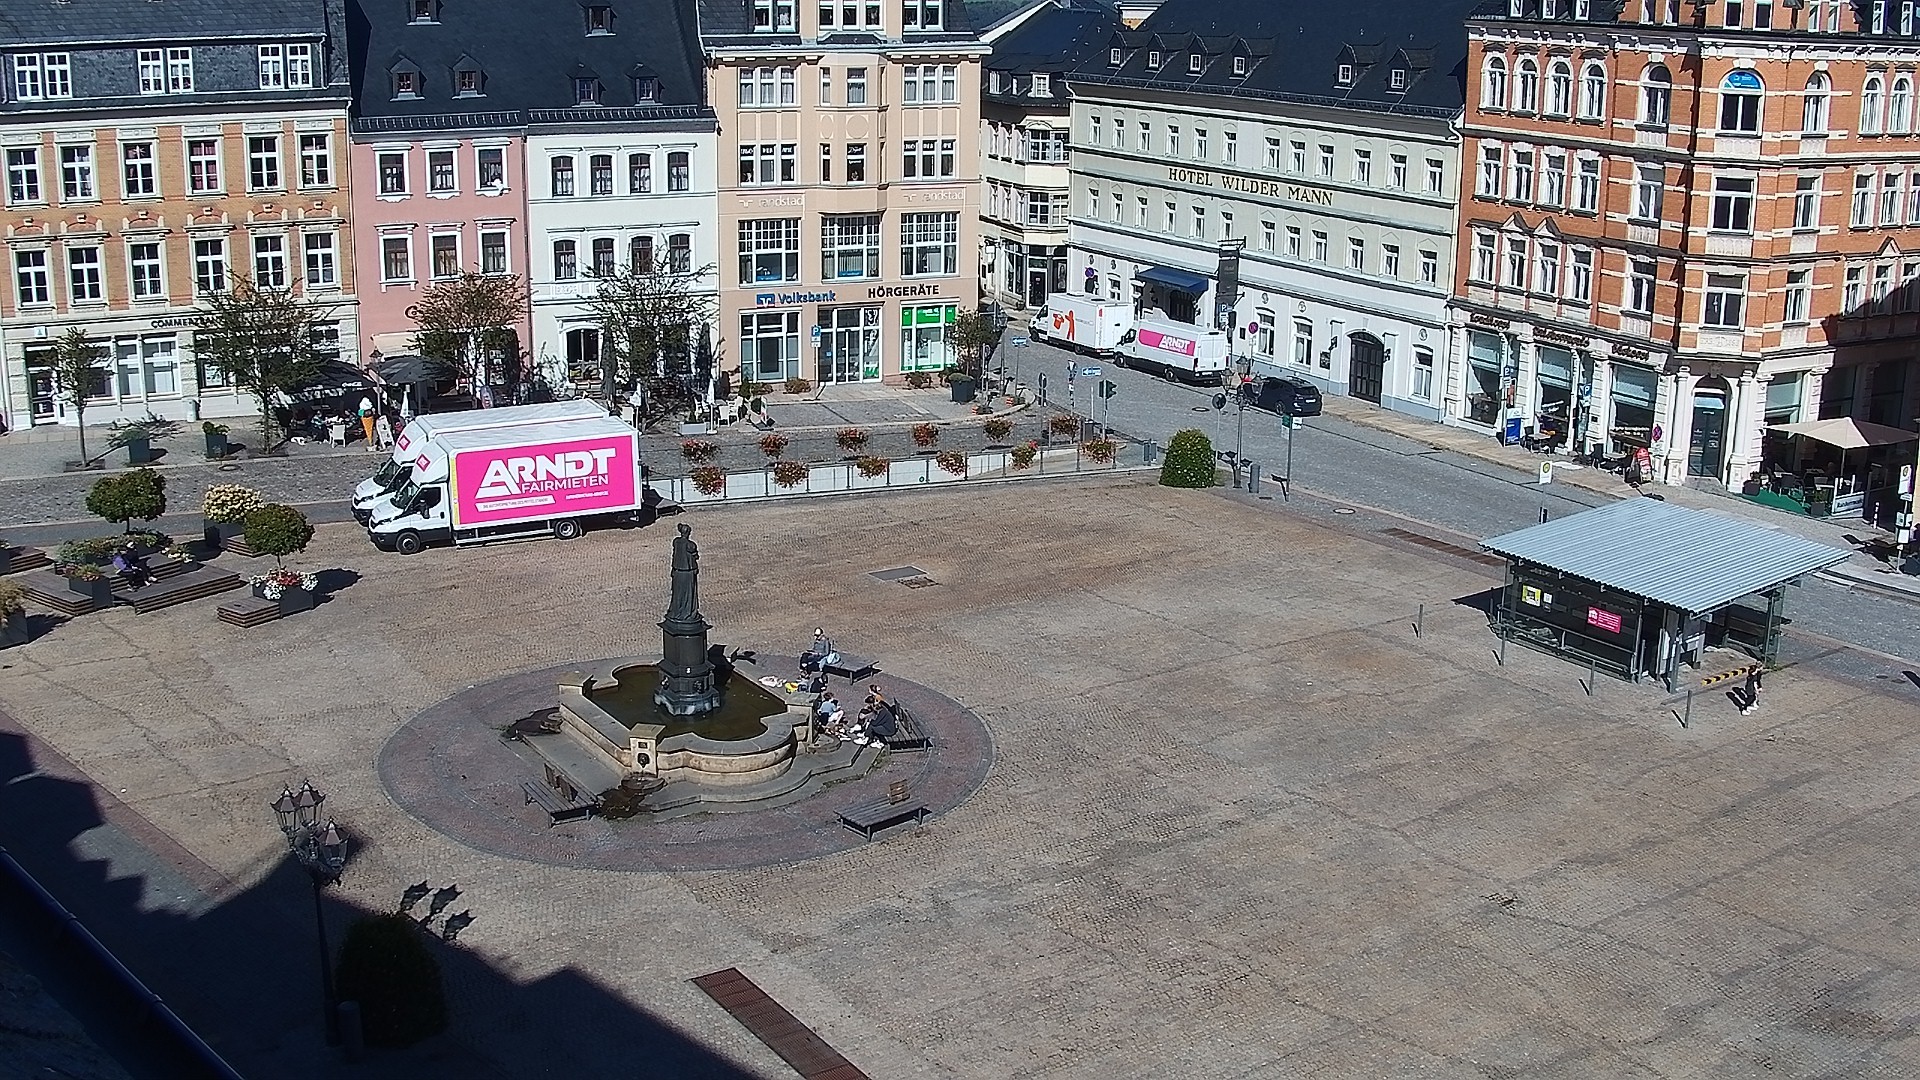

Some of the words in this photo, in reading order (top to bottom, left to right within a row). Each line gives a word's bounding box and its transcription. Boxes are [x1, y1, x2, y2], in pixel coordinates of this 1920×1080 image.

[1168, 168, 1213, 187] HOTEL
[1221, 175, 1280, 199] WILDER
[1287, 186, 1334, 207] MANN
[759, 195, 803, 208] randstad
[778, 291, 836, 305] Volksbank
[868, 283, 940, 299] HÖRGERÄTE
[1158, 335, 1190, 351] ARNDT
[475, 448, 616, 499] ARNDT
[521, 474, 609, 494] FAIRMIETEN
